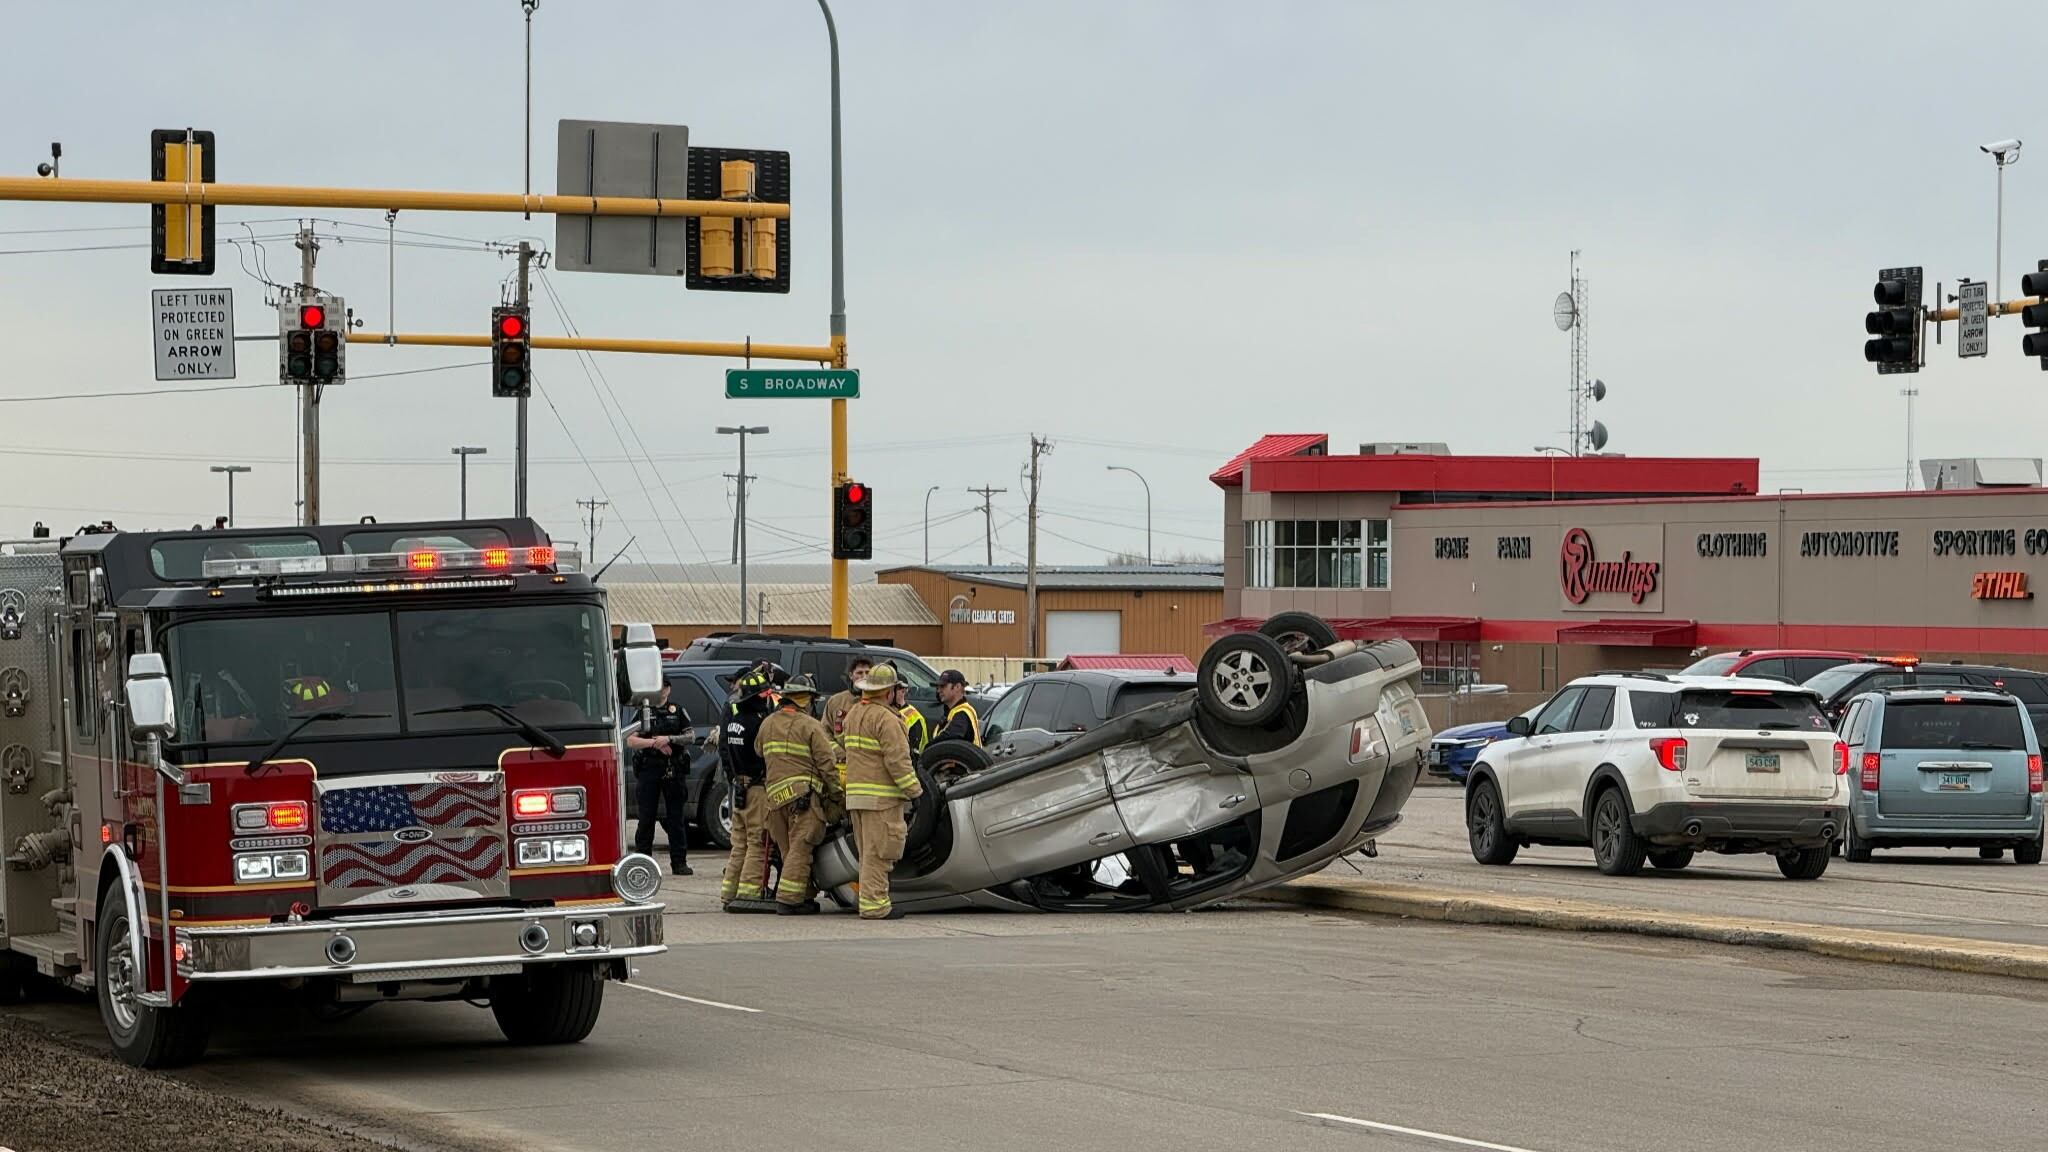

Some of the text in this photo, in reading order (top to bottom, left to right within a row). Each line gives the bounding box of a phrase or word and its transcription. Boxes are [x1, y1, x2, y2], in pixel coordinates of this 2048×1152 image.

[160, 293, 225, 307] LEFT TURN
[161, 311, 225, 324] PROTECTED
[164, 328, 224, 341] ON GREEN
[1963, 328, 1983, 339] ARROW
[167, 345, 222, 358] ARROW
[177, 362, 212, 375] ONLY
[739, 378, 846, 390] S BROADWAY
[1434, 536, 1469, 560] HOME
[1497, 536, 1531, 560] FARM
[1696, 532, 1767, 557] CLOTHING
[1800, 530, 1899, 557] AUTOMOTIVE
[1933, 528, 2048, 556] SPORTING GO
[1560, 527, 1660, 605] Runnings
[1970, 572, 2026, 600] STIHL
